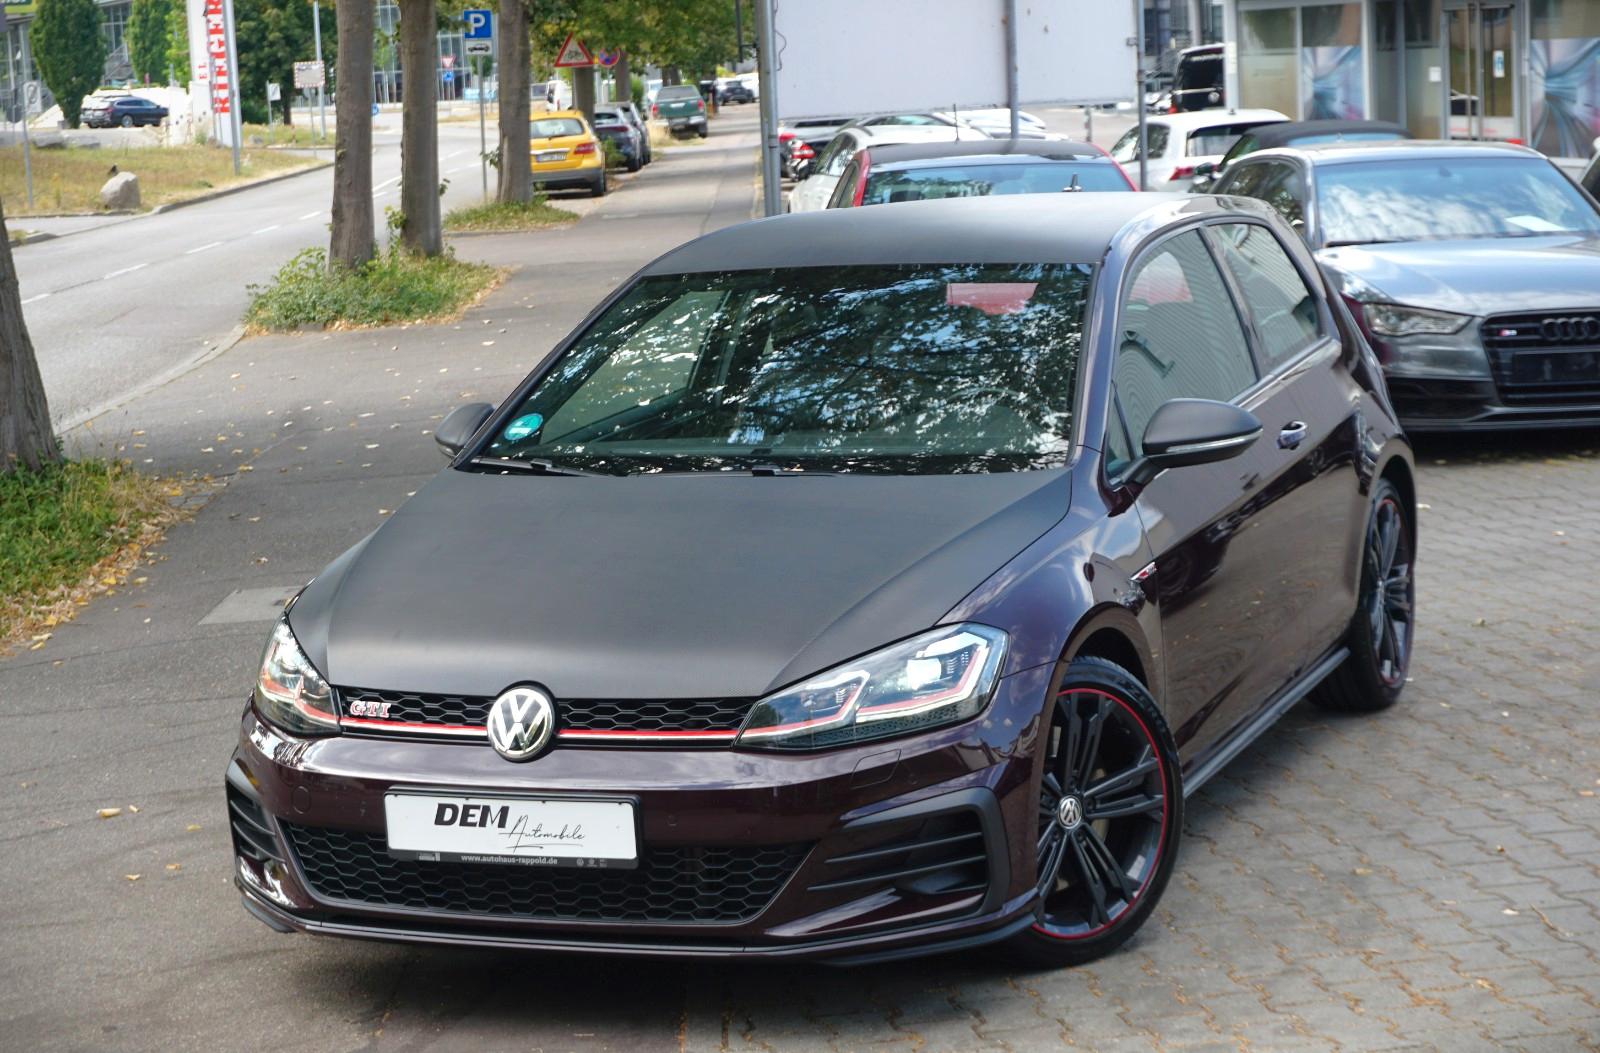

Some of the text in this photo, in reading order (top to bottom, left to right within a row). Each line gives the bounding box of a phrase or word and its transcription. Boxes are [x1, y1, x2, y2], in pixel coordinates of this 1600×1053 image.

[469, 13, 486, 36] P
[350, 700, 391, 719] GTI
[434, 803, 585, 853] DEM Automobile
[460, 854, 558, 866] www.autohaus-rappold.de
